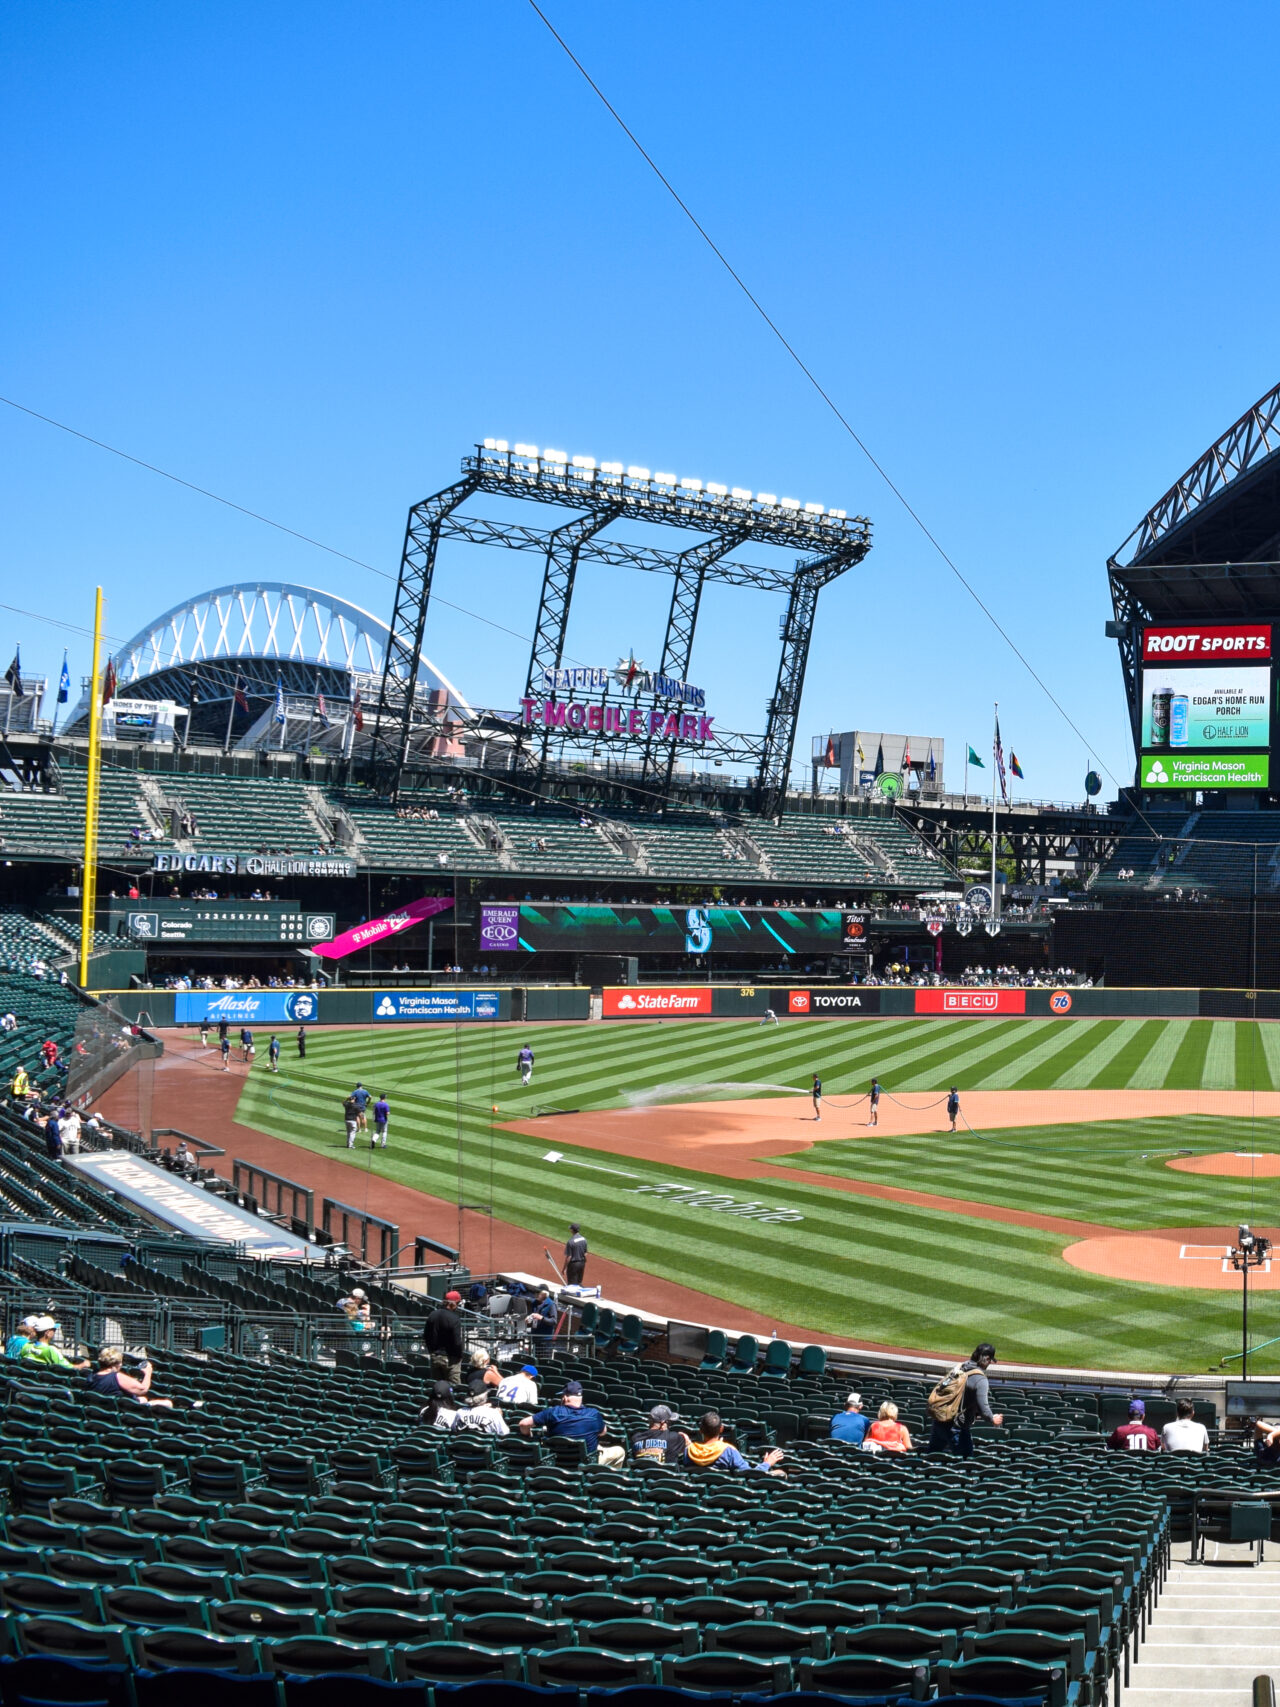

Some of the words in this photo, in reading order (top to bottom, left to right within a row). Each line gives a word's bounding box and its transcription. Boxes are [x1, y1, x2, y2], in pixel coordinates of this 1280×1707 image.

[1147, 635, 1200, 652] ROOT
[1201, 637, 1266, 651] SPORTS
[542, 668, 608, 691] SEATTLE
[643, 671, 707, 708] MARINERS
[1193, 696, 1223, 705] EDGAR'S
[1225, 696, 1247, 705] HOME
[1249, 696, 1265, 704] RUN
[1216, 707, 1241, 715] PORCH
[519, 697, 644, 734] T-MOBILE
[647, 710, 716, 741] PARK
[1217, 726, 1234, 736] HALF
[1234, 725, 1249, 736] LION
[1173, 761, 1210, 773] Virginia
[1212, 762, 1245, 770] Mason
[1173, 773, 1226, 782] Franciscan
[1228, 772, 1261, 782] Health
[264, 860, 287, 873] HALF
[288, 860, 307, 874] LION
[161, 921, 193, 929] Colorado
[930, 923, 940, 931] 42
[161, 931, 186, 939] Seattle
[740, 989, 755, 997] 376
[207, 995, 261, 1011] Alaska
[399, 997, 431, 1006] Virginia
[432, 997, 458, 1005] Mason
[814, 996, 862, 1007] TOYOTA
[948, 995, 995, 1007] BECU
[1053, 996, 1069, 1008] 76
[399, 1006, 443, 1014] Franciscan
[444, 1006, 470, 1014] Health
[498, 1385, 519, 1400] 24
[645, 1438, 668, 1449] DIEGO
[1126, 1433, 1148, 1450] 10
